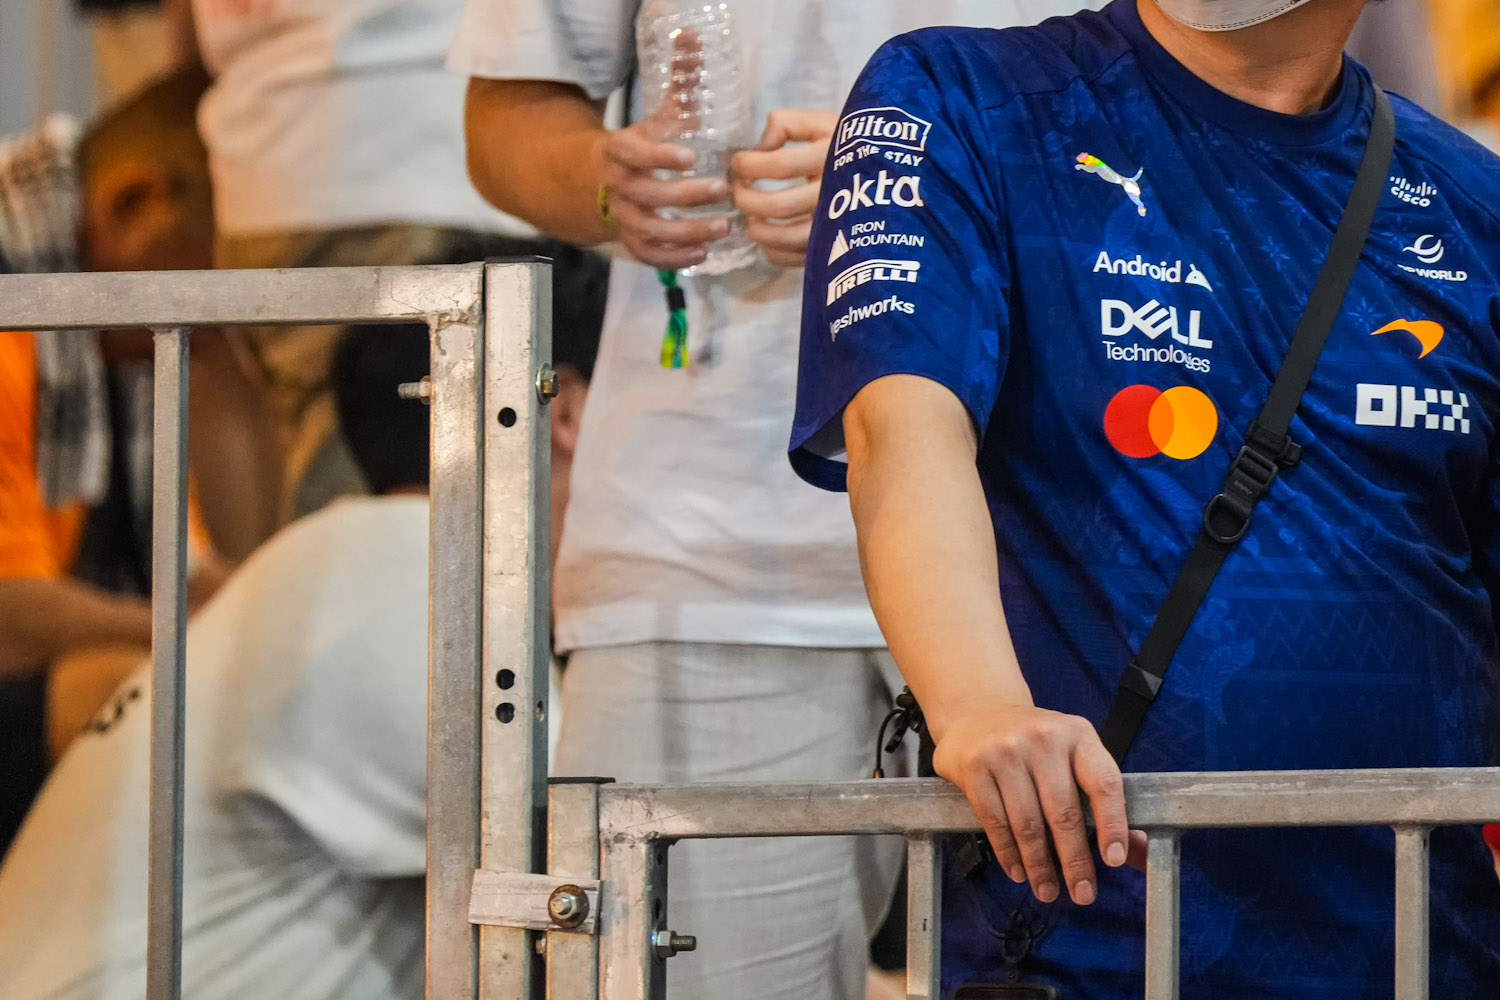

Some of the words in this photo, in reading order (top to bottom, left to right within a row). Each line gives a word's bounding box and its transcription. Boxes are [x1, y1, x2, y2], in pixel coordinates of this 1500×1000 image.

[840, 115, 920, 144] Hilton
[834, 152, 854, 171] FOR
[856, 144, 880, 160] THE
[884, 151, 924, 167] STAY
[828, 169, 925, 220] okta
[849, 233, 925, 250] MOUNTAIN
[851, 220, 886, 236] IRON
[1092, 250, 1182, 283] Android
[1415, 268, 1468, 282] WORLD
[826, 259, 921, 306] PIRELLI
[1100, 299, 1213, 349] DELL
[1355, 383, 1470, 434] OKX
